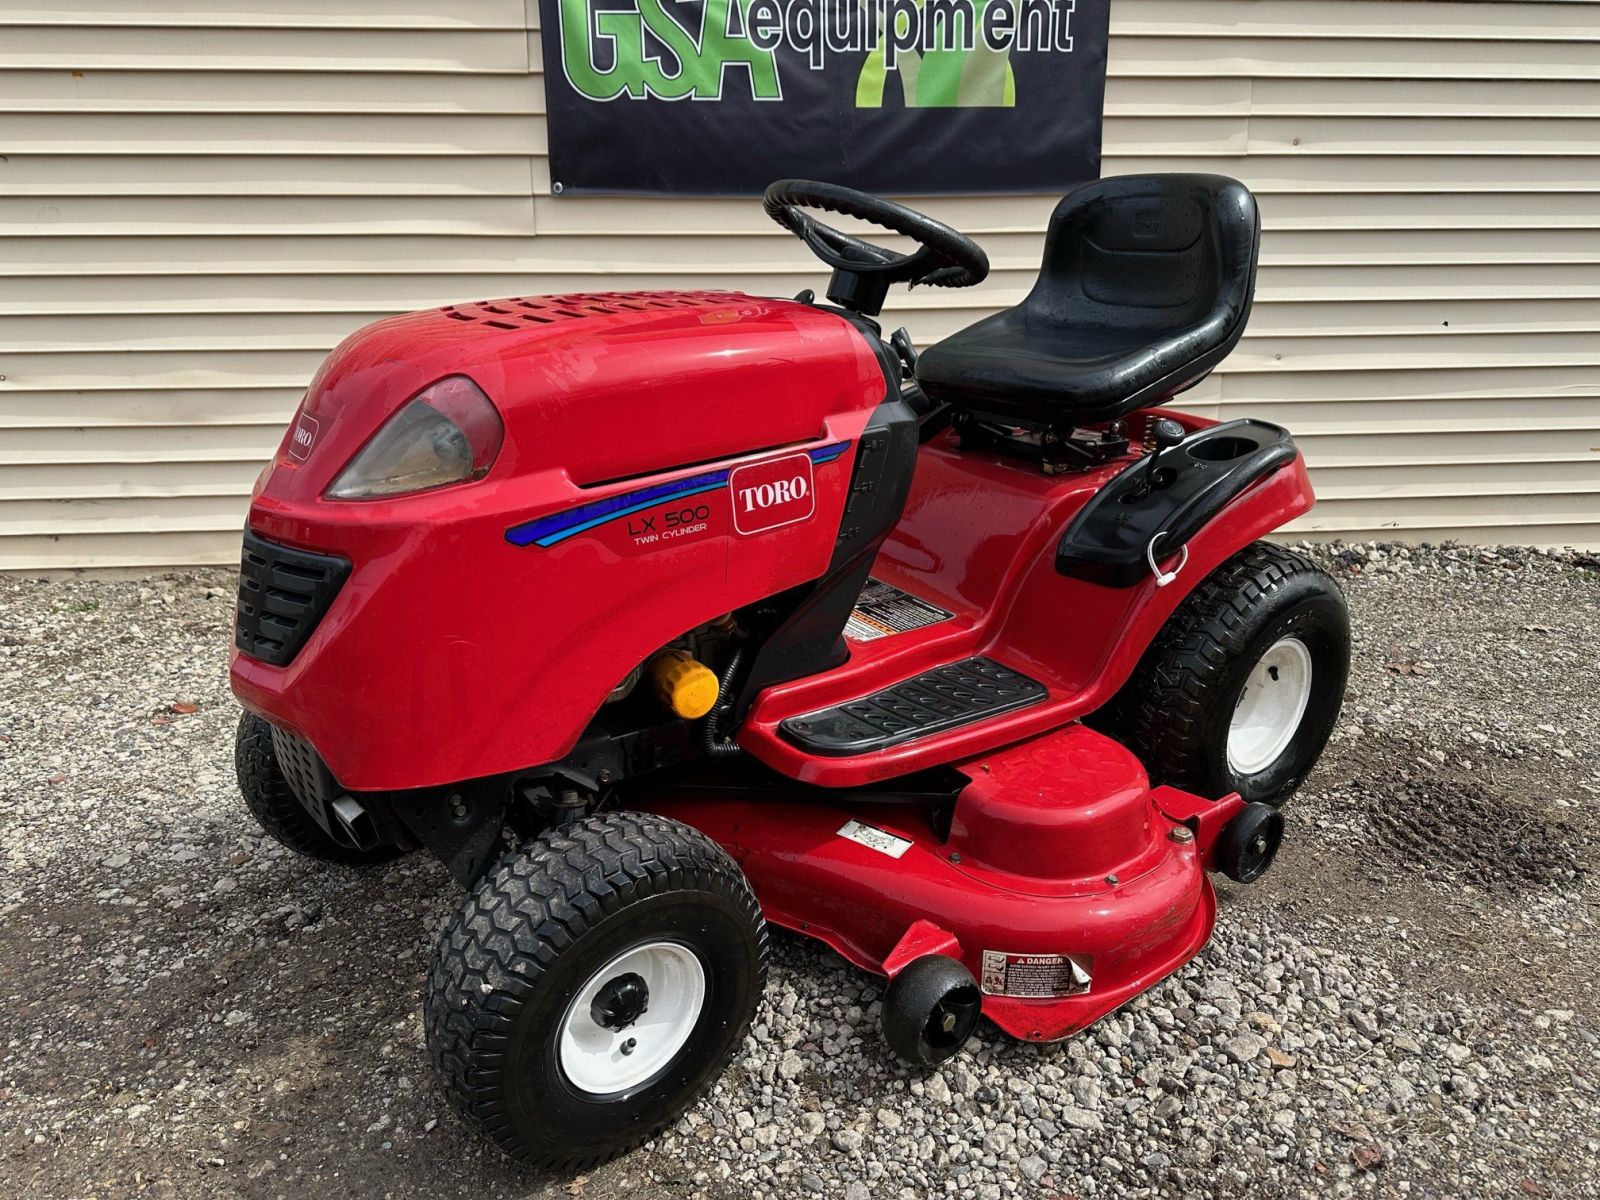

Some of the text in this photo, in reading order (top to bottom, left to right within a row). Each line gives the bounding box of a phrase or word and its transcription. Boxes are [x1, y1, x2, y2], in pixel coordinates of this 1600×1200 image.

[558, 0, 1076, 102] GSA equipment
[739, 476, 808, 513] TORO
[627, 505, 711, 536] LX 500
[634, 523, 708, 546] TWIN CYLINDER
